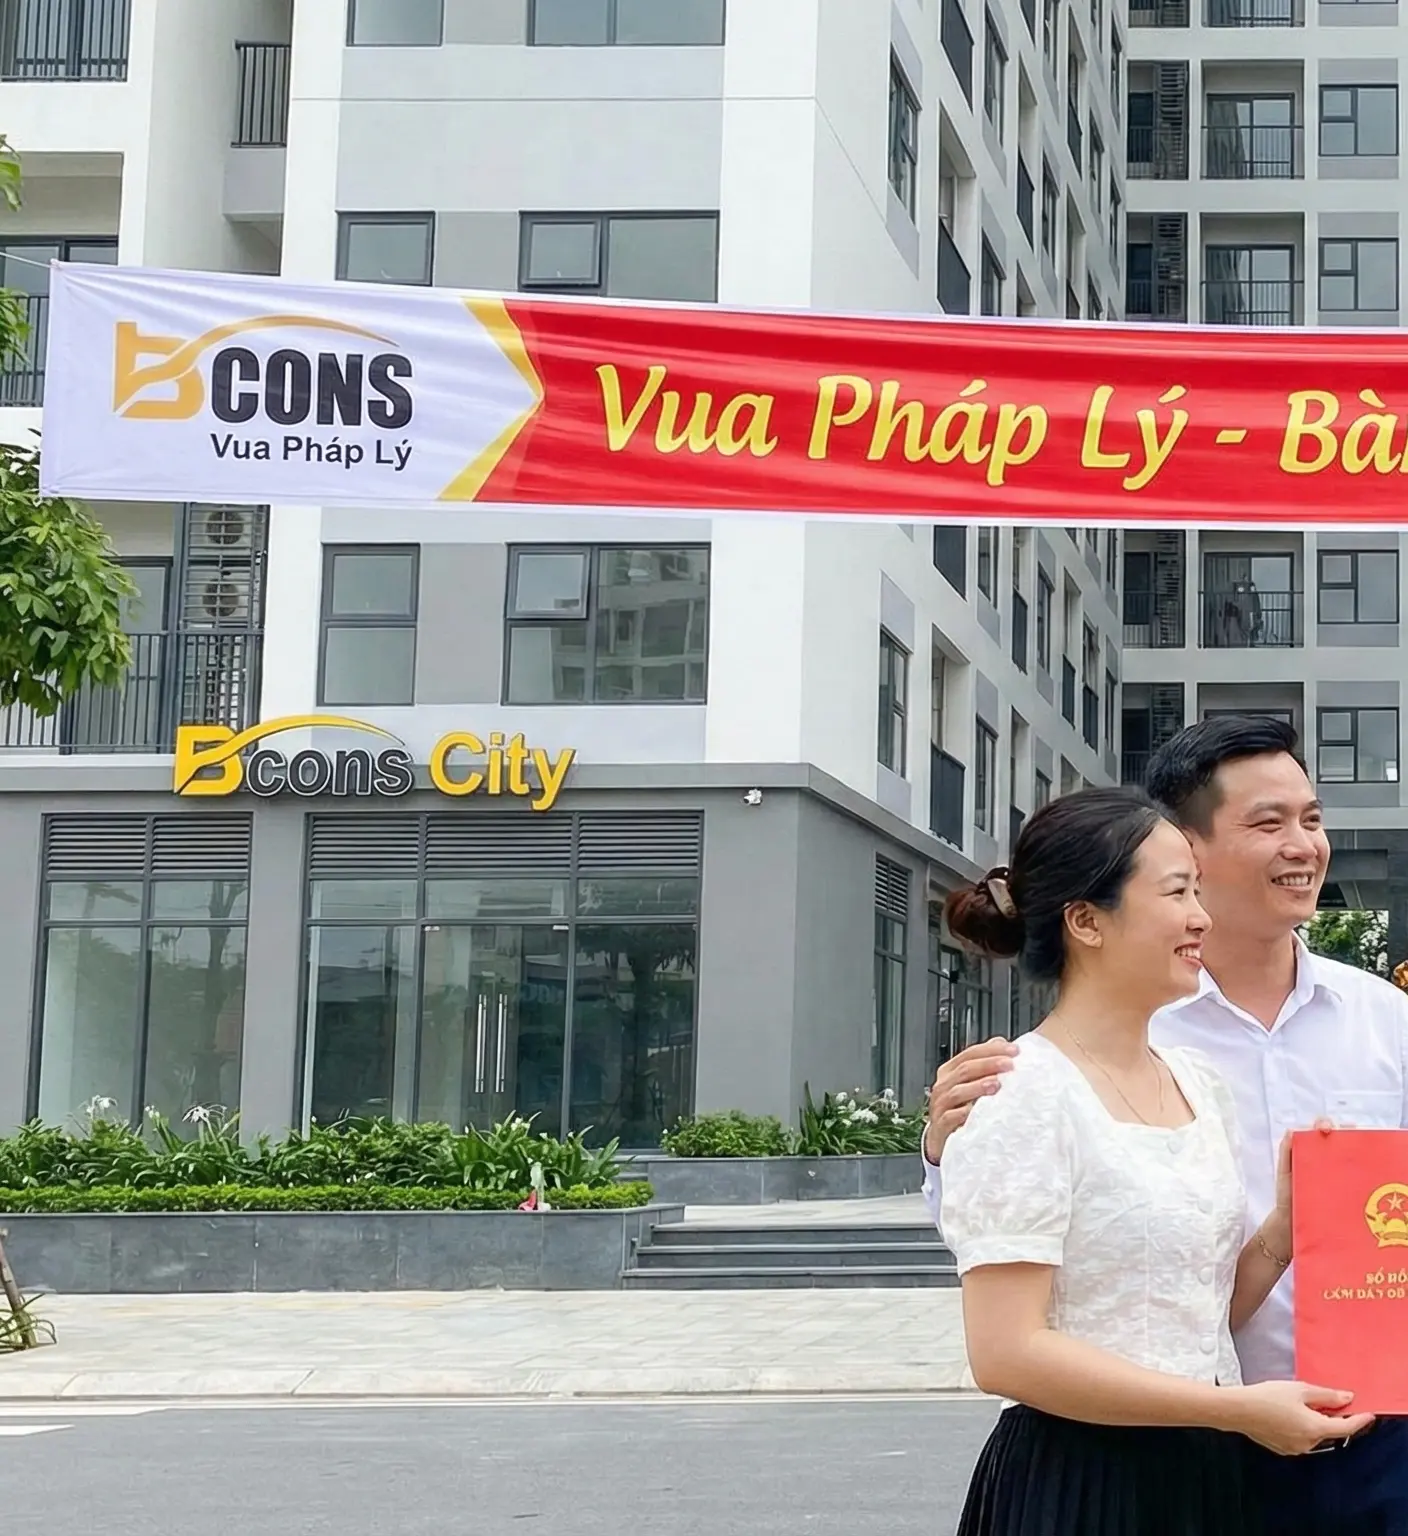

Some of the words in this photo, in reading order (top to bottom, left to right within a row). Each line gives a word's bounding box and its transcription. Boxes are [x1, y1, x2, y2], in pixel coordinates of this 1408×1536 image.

[210, 432, 271, 461] Vua
[282, 435, 364, 470] Pháp
[374, 438, 413, 472] Lý
[596, 364, 778, 457] Vua
[808, 374, 1048, 486] Pháp
[1081, 384, 1188, 490] Lý
[429, 731, 574, 811] City
